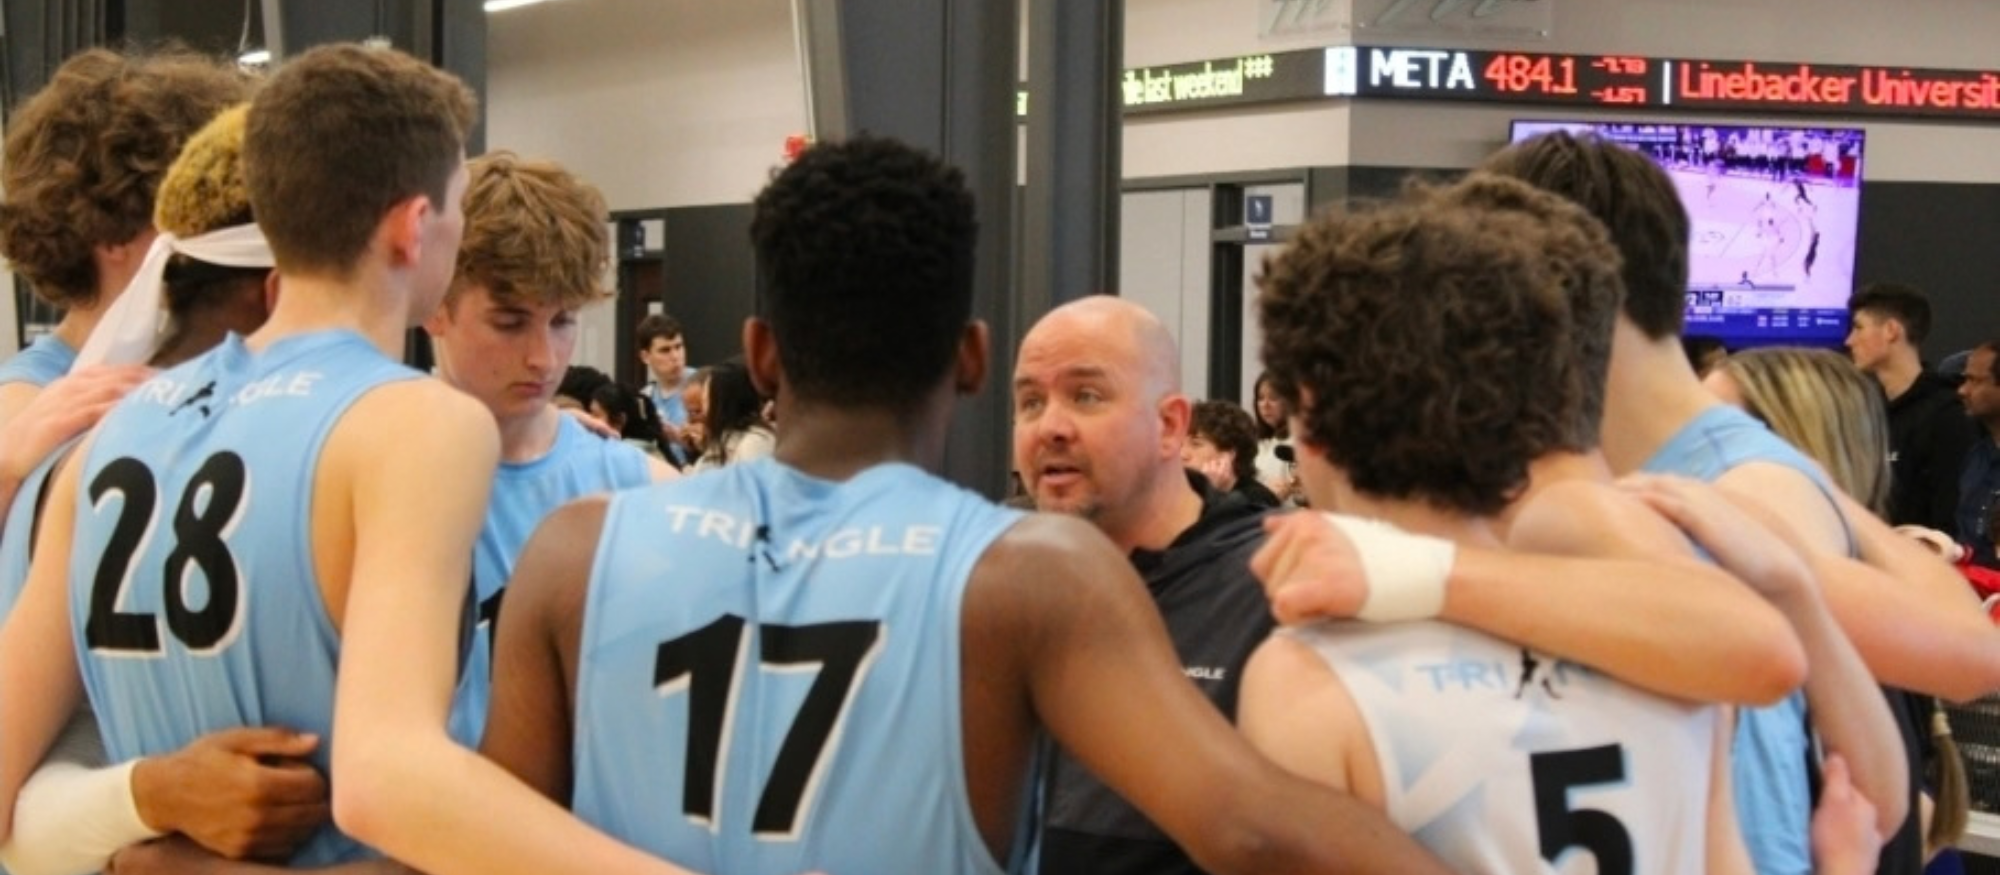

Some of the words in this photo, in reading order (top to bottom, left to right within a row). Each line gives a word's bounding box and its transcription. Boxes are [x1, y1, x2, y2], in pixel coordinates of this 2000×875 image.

[1144, 68, 1172, 102] last
[1173, 58, 1243, 101] weekend
[1369, 48, 1476, 90] META
[1484, 53, 1578, 94] 484.1
[1680, 61, 1856, 102] Linebacker
[1862, 68, 2000, 109] Universit
[86, 450, 250, 659] 28
[665, 503, 943, 566] TRINGLE
[653, 612, 887, 842] 17
[1529, 742, 1639, 875] 5
